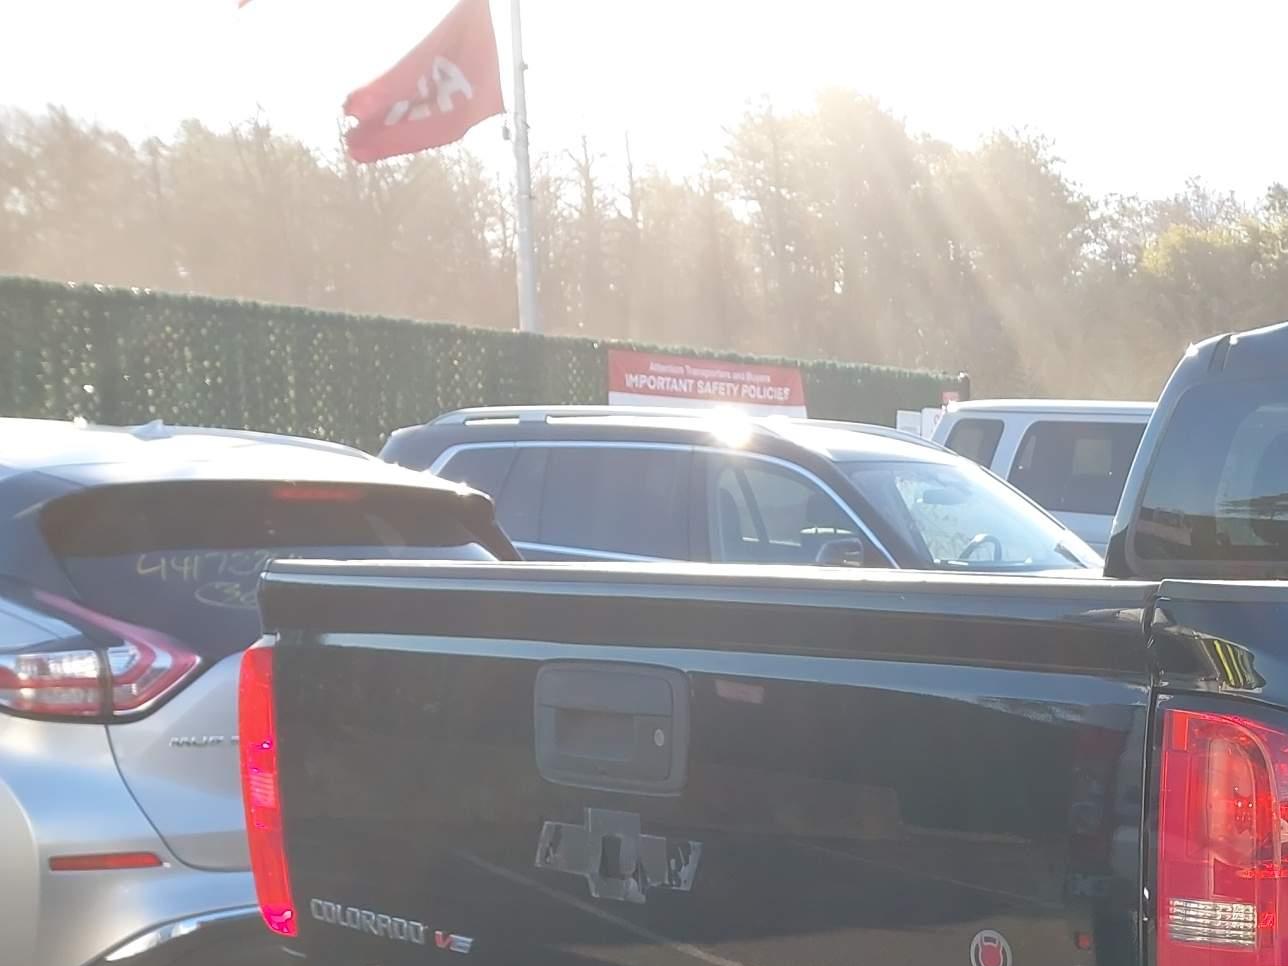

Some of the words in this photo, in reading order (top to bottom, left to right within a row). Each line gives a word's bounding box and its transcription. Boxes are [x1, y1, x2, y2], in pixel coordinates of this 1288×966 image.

[625, 373, 694, 393] IMPORTANT
[697, 379, 740, 398] SAFETY
[741, 384, 791, 401] POLICIES
[310, 898, 425, 945] COLORADO
